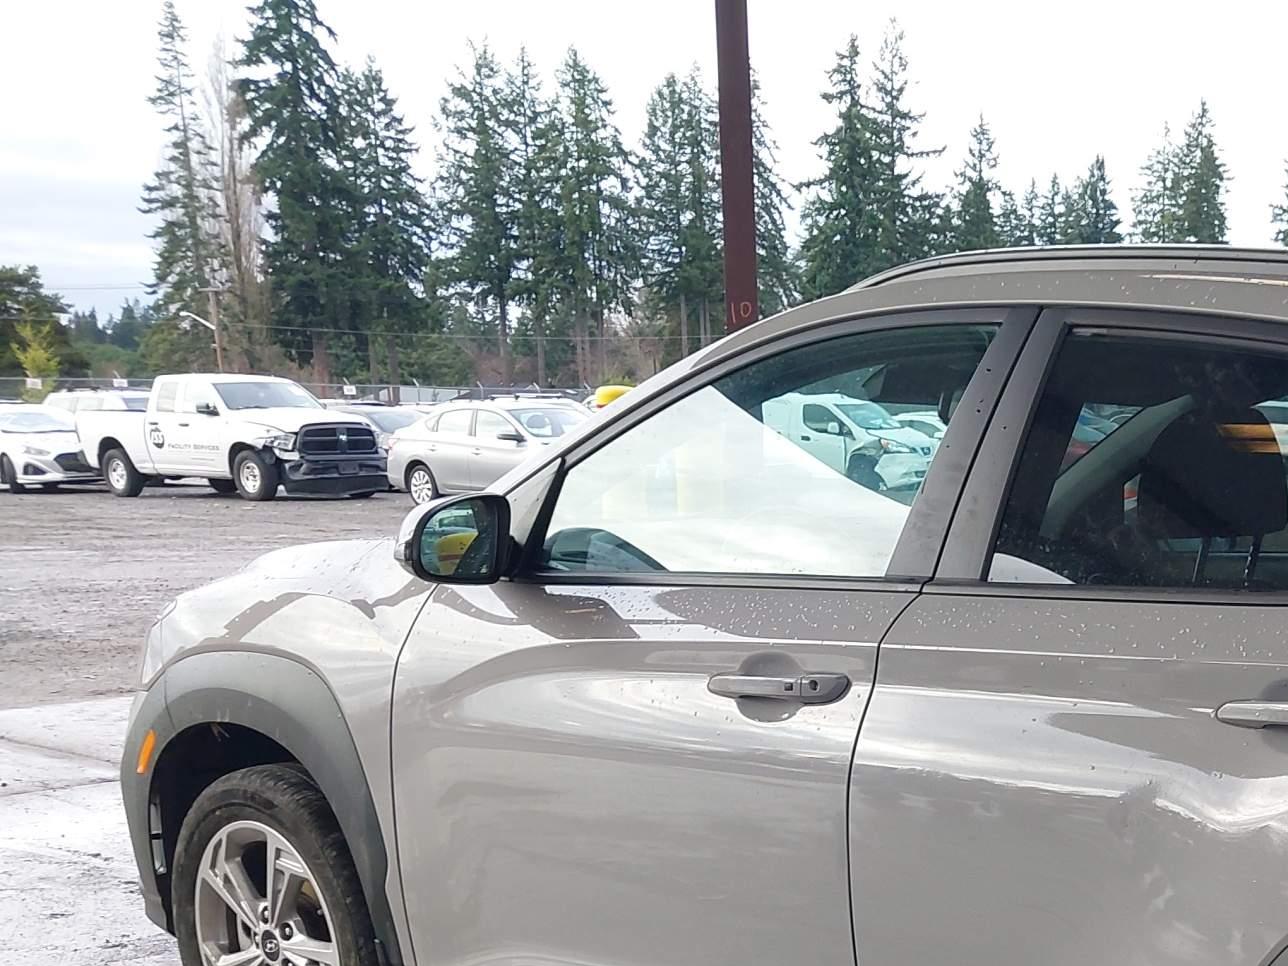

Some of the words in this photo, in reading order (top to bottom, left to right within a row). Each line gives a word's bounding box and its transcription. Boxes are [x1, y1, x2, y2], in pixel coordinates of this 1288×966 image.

[730, 301, 753, 324] 10
[167, 442, 191, 450] FACILITY
[192, 443, 220, 451] SERVICES
